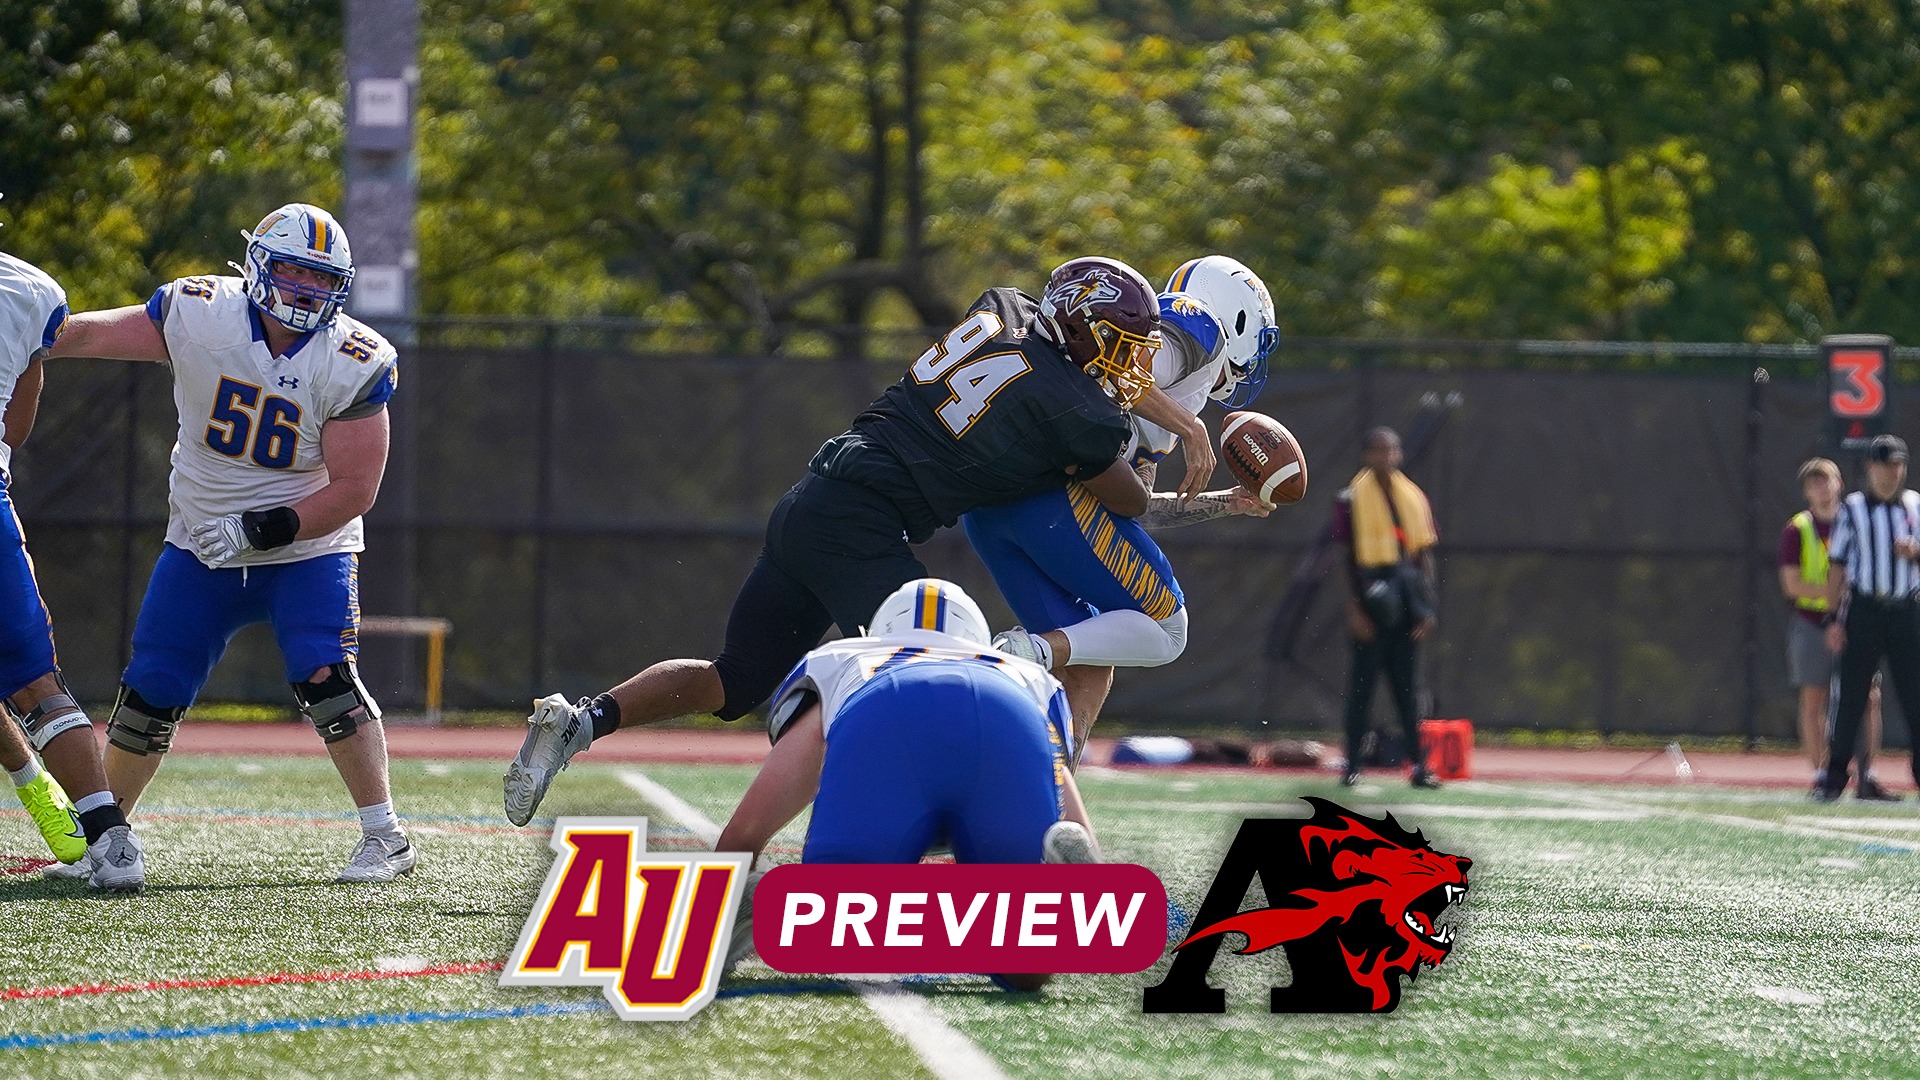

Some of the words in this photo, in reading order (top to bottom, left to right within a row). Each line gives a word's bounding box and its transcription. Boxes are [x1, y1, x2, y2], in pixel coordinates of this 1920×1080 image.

[337, 330, 379, 364] 56
[909, 310, 1034, 440] 94
[1829, 350, 1885, 417] 3
[204, 375, 303, 469] 56
[1242, 433, 1270, 467] Wilson
[561, 711, 582, 748] NIKE
